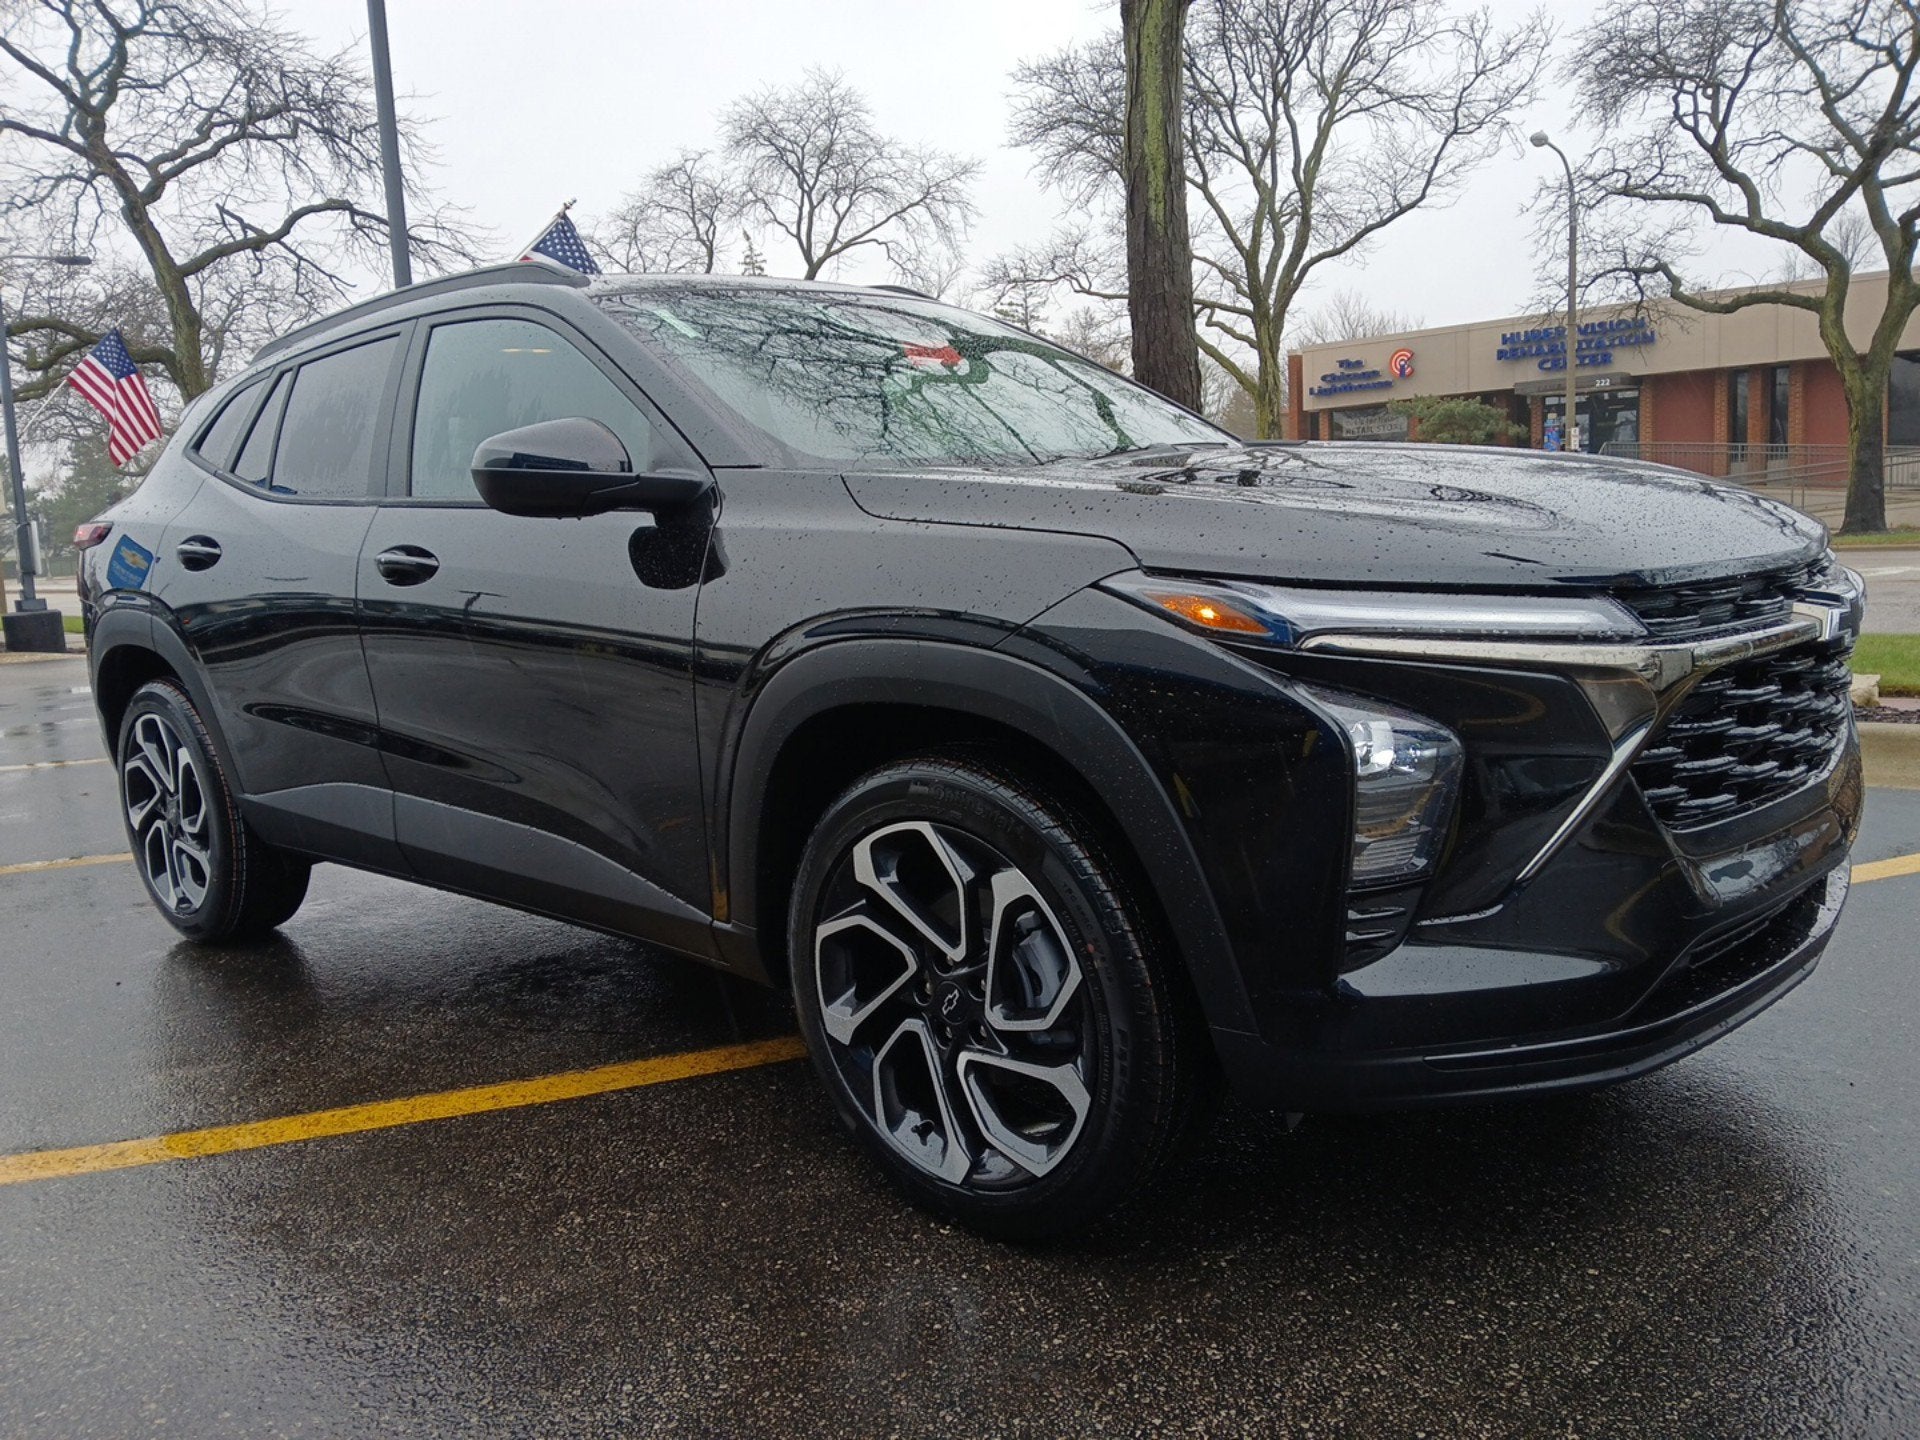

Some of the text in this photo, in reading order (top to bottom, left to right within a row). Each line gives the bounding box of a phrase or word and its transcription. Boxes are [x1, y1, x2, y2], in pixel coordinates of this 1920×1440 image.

[1496, 330, 1656, 361] REHABIITATION
[1501, 316, 1646, 346] HUBER VISION
[1595, 378, 1611, 388] 222
